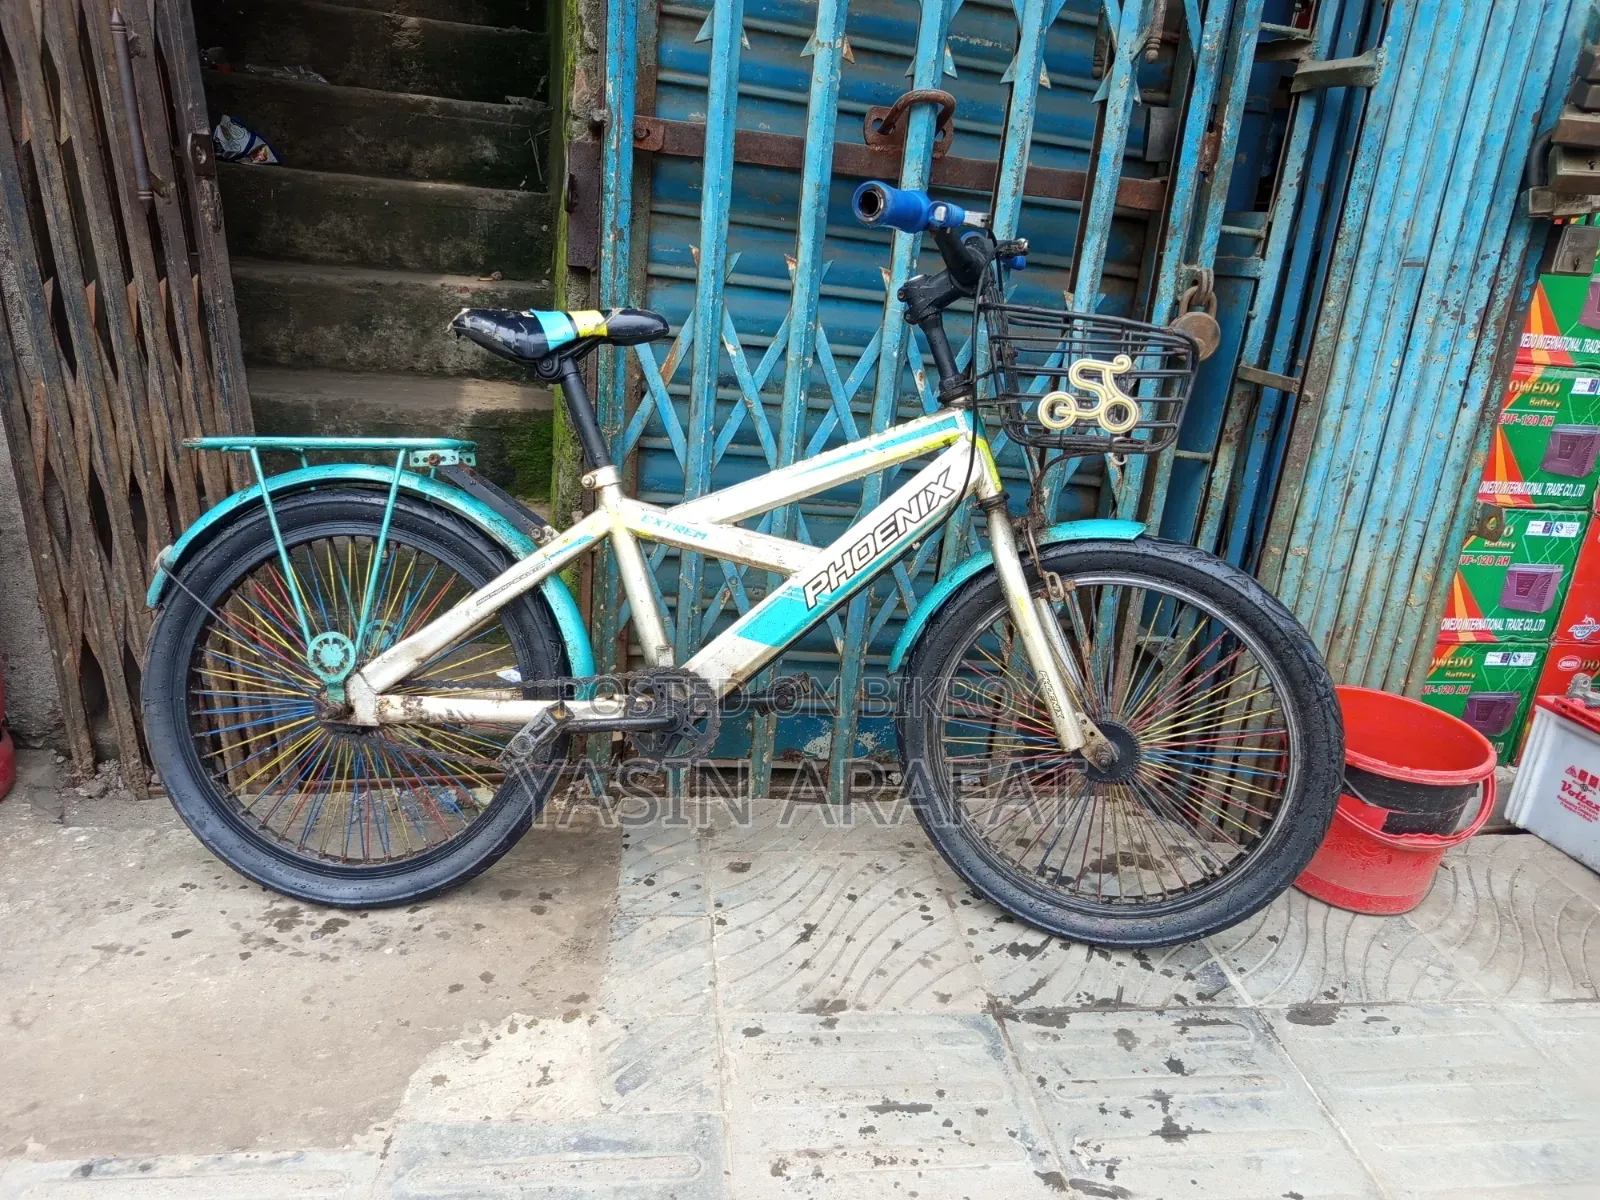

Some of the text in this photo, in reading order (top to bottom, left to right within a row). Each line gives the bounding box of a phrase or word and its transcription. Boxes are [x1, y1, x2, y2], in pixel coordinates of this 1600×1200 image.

[1537, 334, 1582, 352] INTERNATIONAL
[1508, 380, 1560, 396] OWEDO
[1529, 397, 1562, 410] Battery
[1539, 414, 1555, 427] AH
[1500, 481, 1545, 496] INTERNATIONAL
[1543, 482, 1564, 497] TRADE
[640, 513, 709, 541] EXTREM
[803, 465, 956, 612] PHOENIX
[1459, 554, 1511, 567] VF-120 AH
[1462, 617, 1506, 631] INTERNATIONAL
[1505, 618, 1525, 631] TRADE
[1039, 670, 1065, 719] PHOENIX
[1422, 685, 1471, 694] VF-120 AH
[1561, 780, 1600, 812] Voltex
